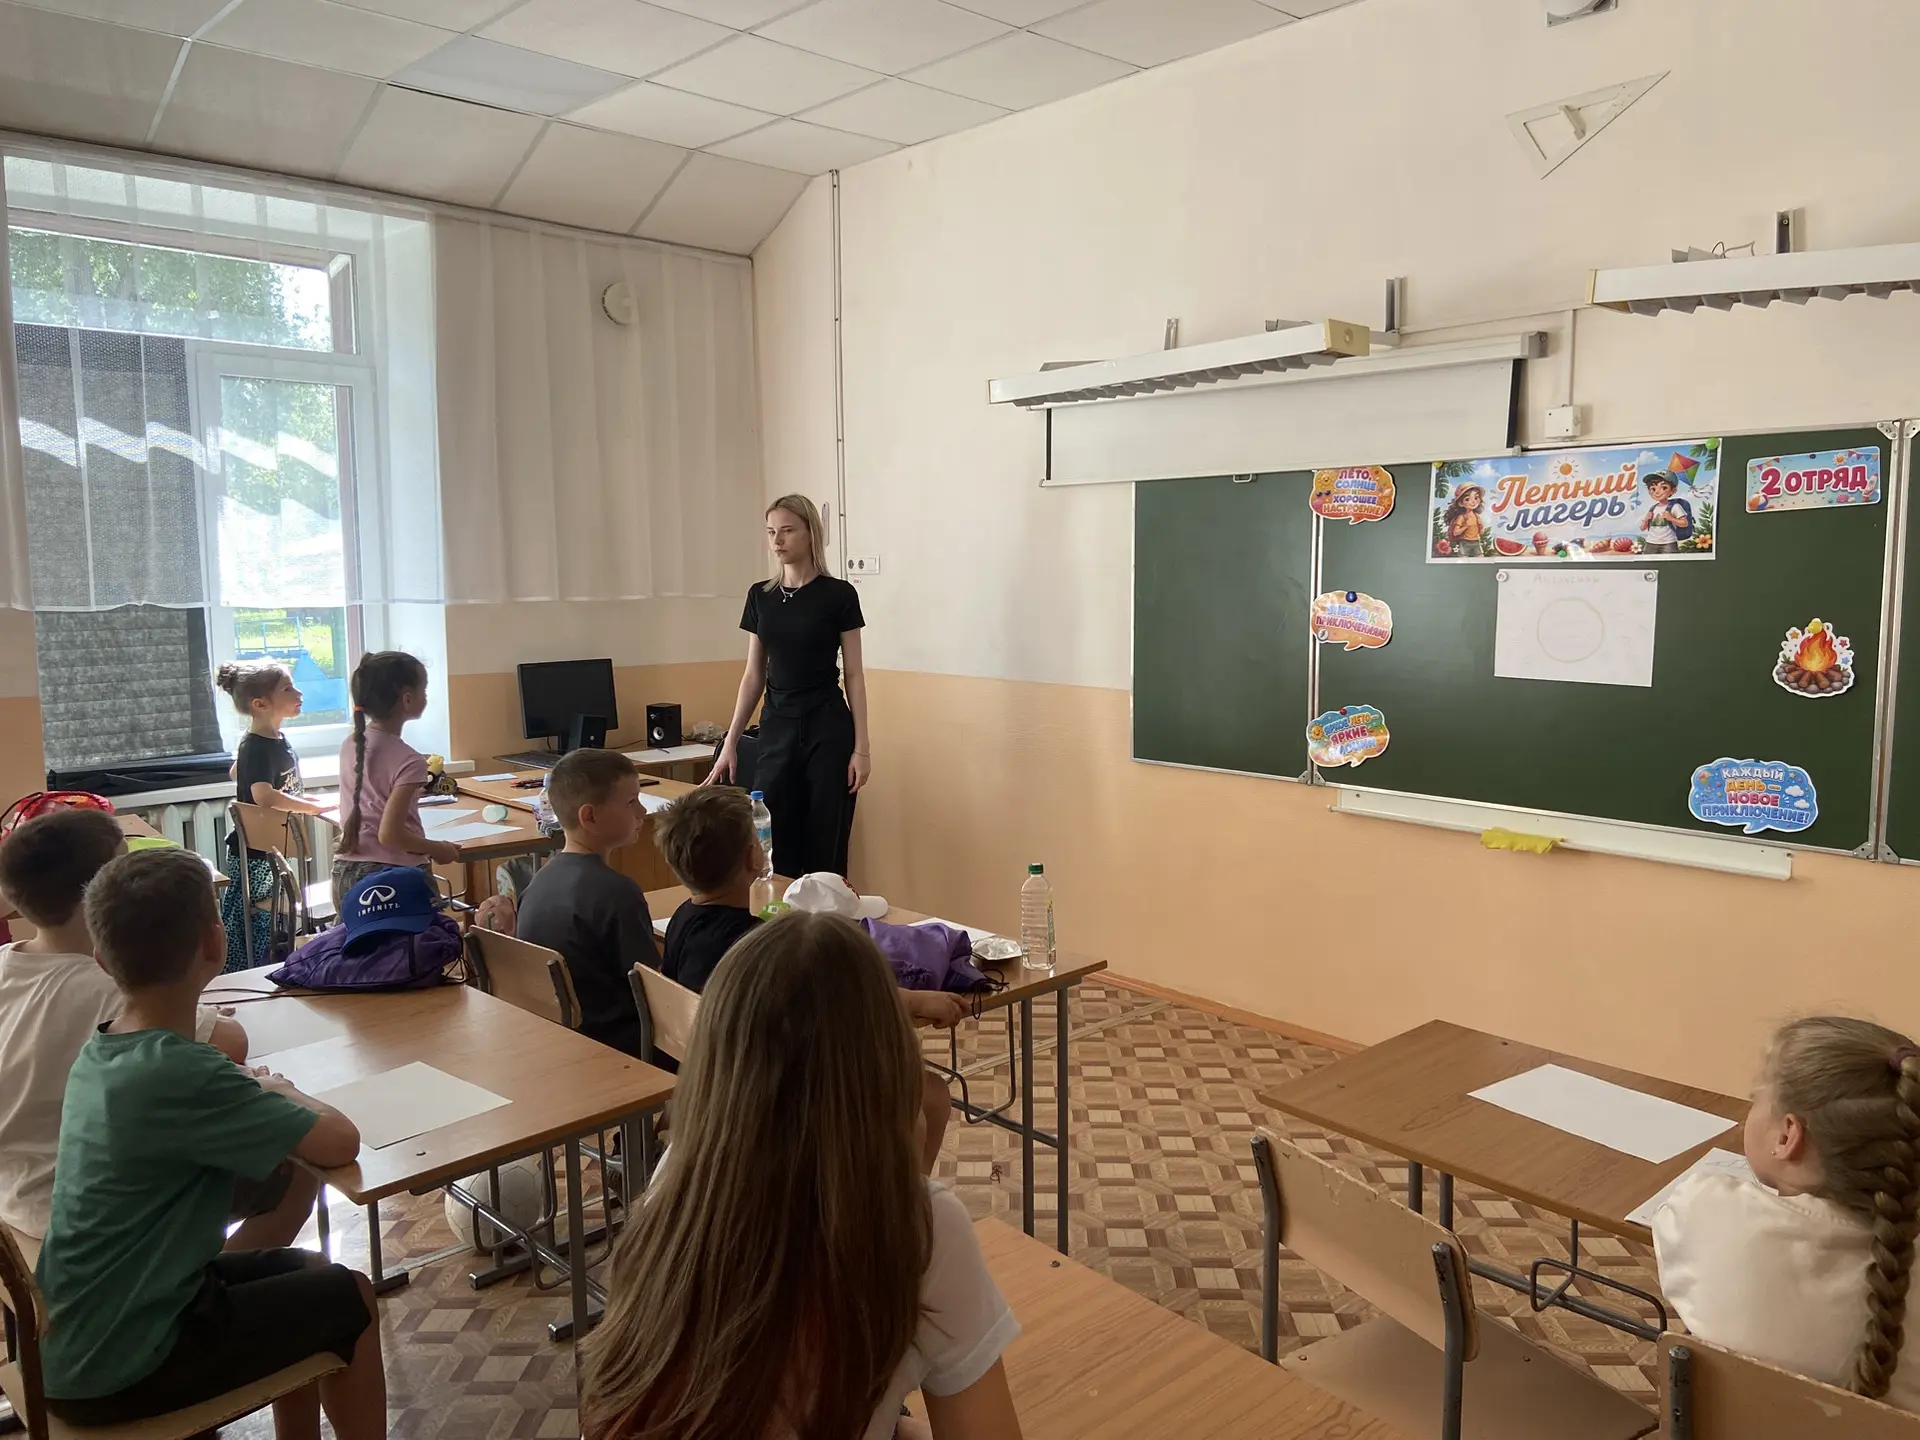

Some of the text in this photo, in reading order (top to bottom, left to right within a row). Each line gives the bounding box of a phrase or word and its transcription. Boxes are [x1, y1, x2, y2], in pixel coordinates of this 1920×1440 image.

[1339, 469, 1372, 481] ЛЕТО,
[1761, 466, 1868, 495] 2 ОТРЯД
[1335, 480, 1377, 492] СОЛНЦЕ
[1492, 464, 1637, 512] Летний
[1333, 495, 1377, 505] ХОРОШЕЕ
[1506, 497, 1625, 532] лагерь
[1330, 726, 1367, 745] ЯРКИЕ
[1722, 767, 1784, 781] КАЖДЫЙ
[1726, 780, 1766, 792] ДЕНЬ
[1728, 792, 1779, 806] НОВОЕ
[1702, 805, 1810, 823] ПРИКЛЮЧЕНИЕ!
[358, 903, 400, 917] INFINITI
